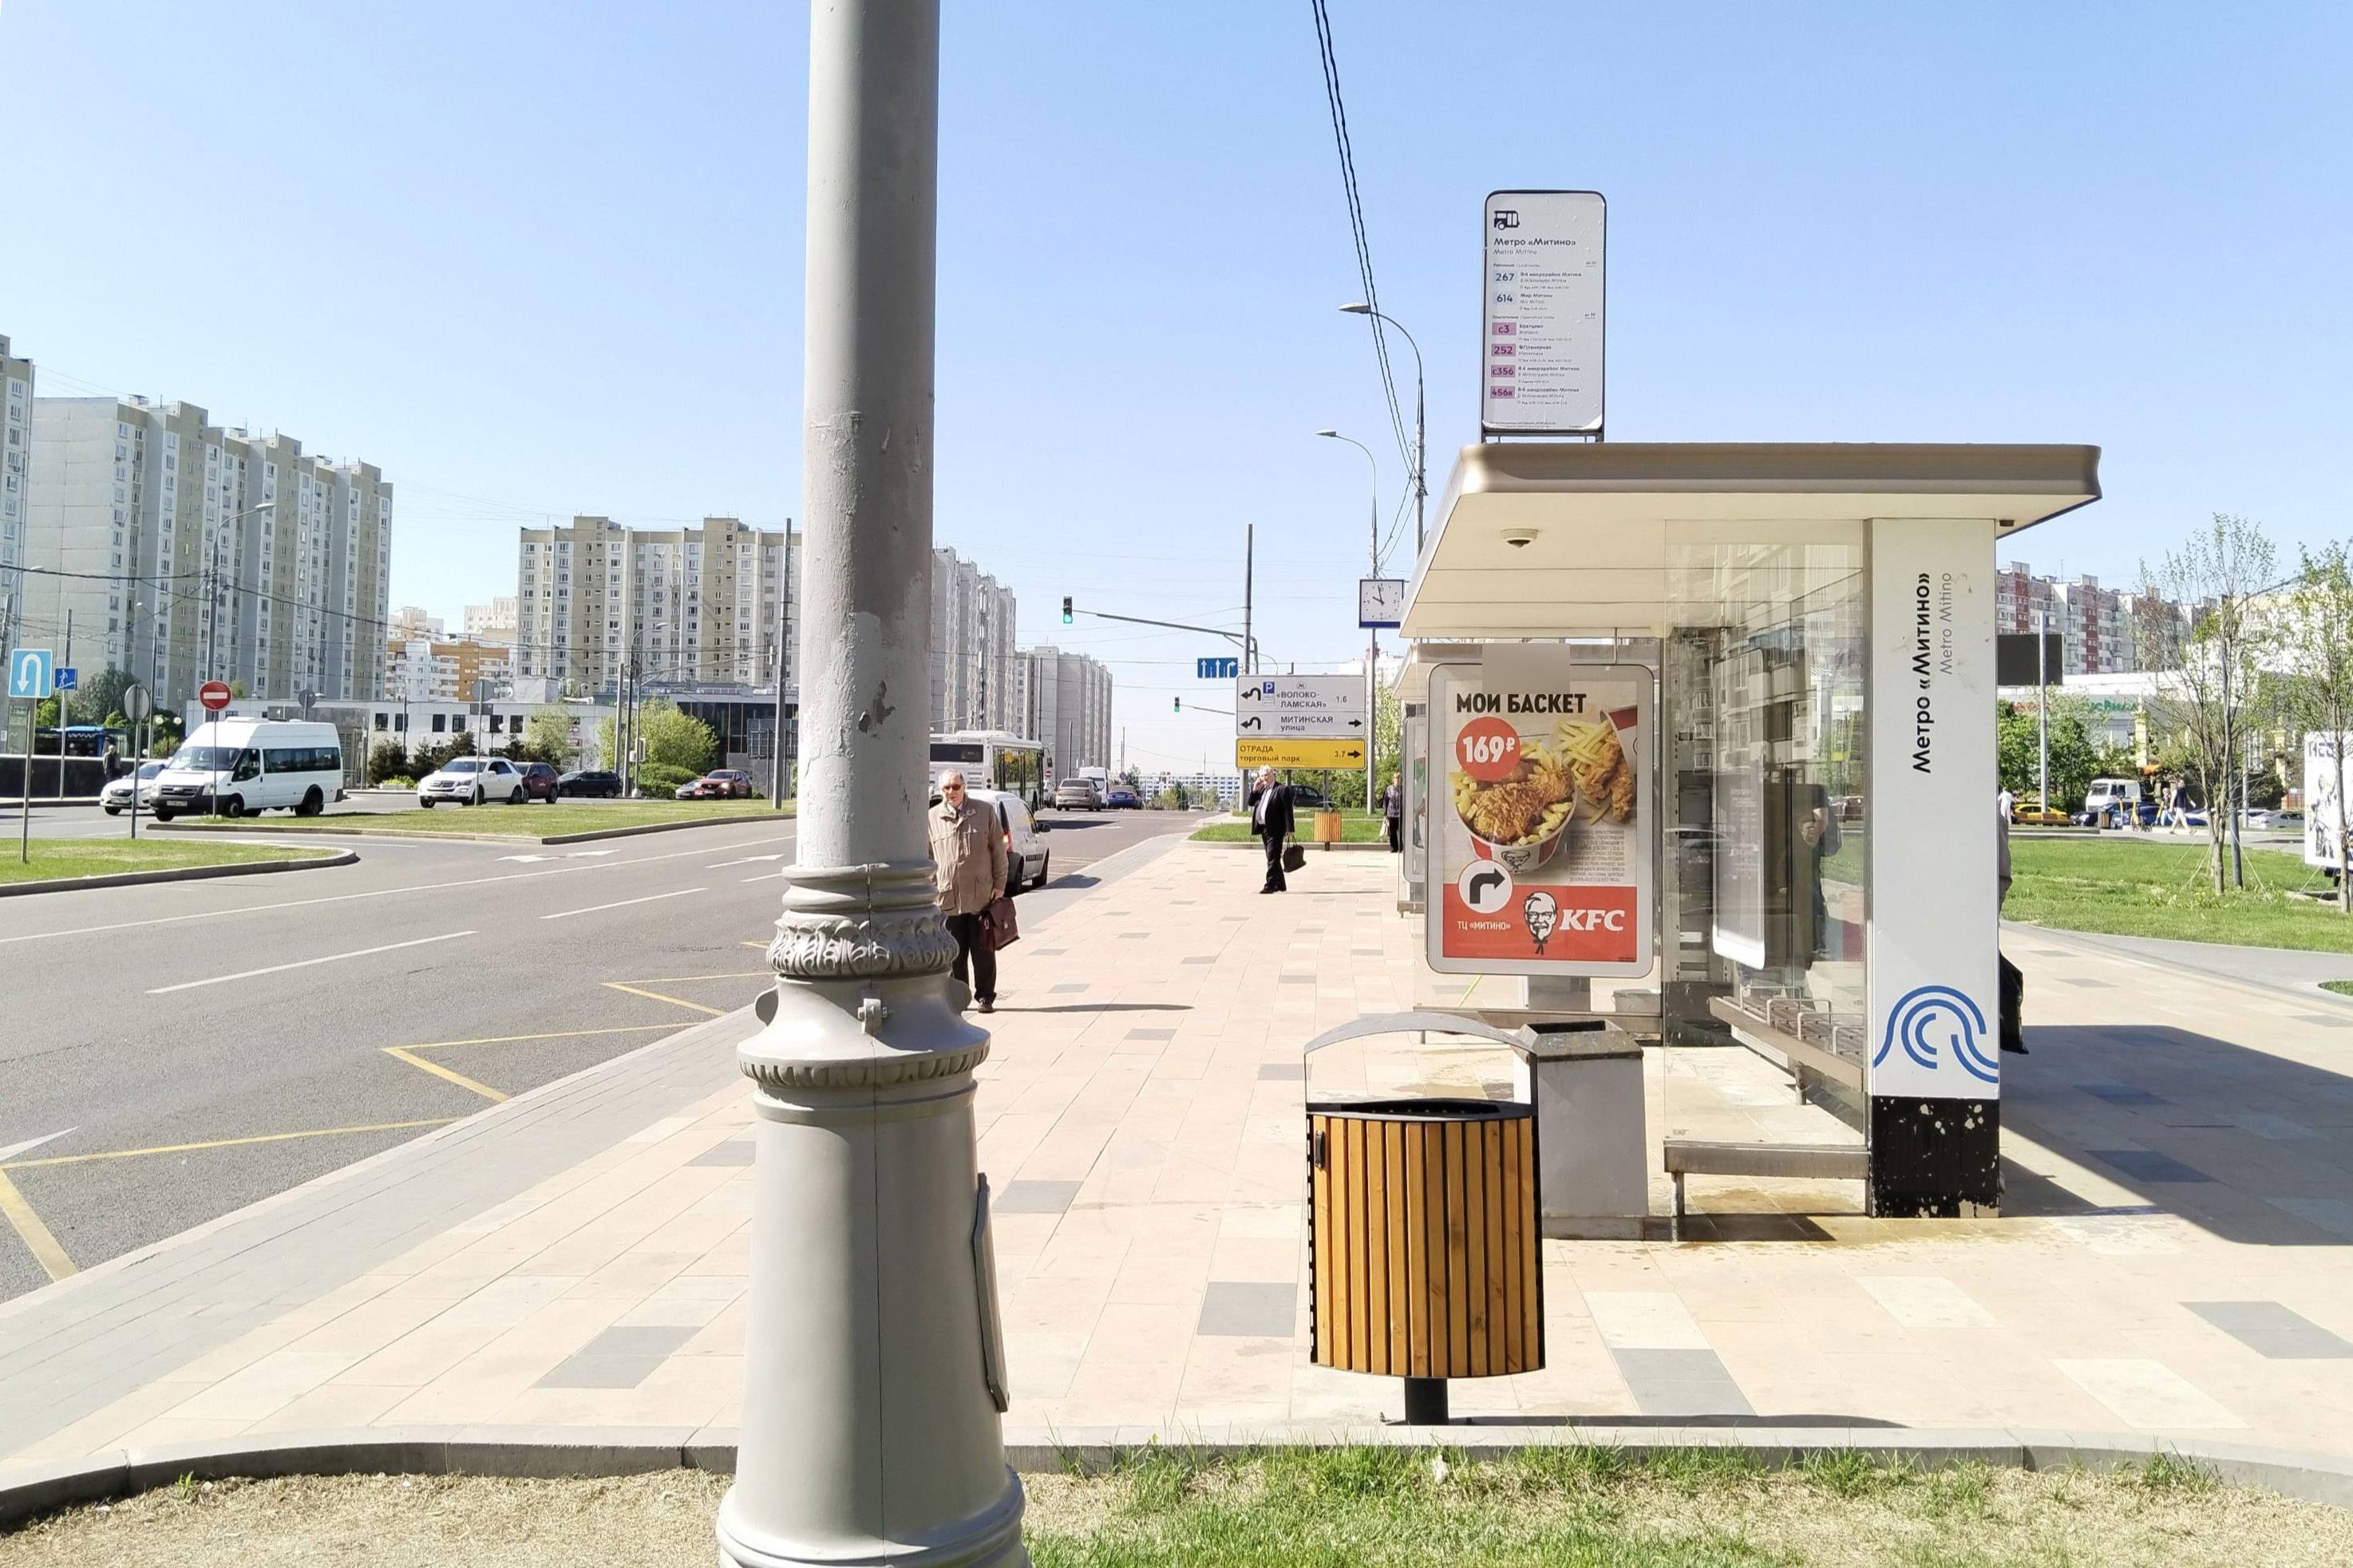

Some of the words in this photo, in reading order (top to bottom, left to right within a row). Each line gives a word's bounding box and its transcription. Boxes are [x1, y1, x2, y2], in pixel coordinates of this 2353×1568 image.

[1494, 239, 1525, 247] Метро
[1496, 273, 1514, 282] 267
[1497, 294, 1513, 302] 614
[1494, 346, 1513, 354] 252
[1940, 572, 1952, 622] Mitino
[1912, 573, 1931, 689] «Митино»
[1940, 628, 1953, 675] Metro
[1508, 693, 1587, 713] БАСКЕТ
[1912, 696, 1934, 773] Метро
[1240, 754, 1279, 763] торговый
[1457, 921, 1468, 931] ТЦ
[1469, 921, 1511, 931] «МИТИНО»
[1559, 909, 1625, 931] KFC
